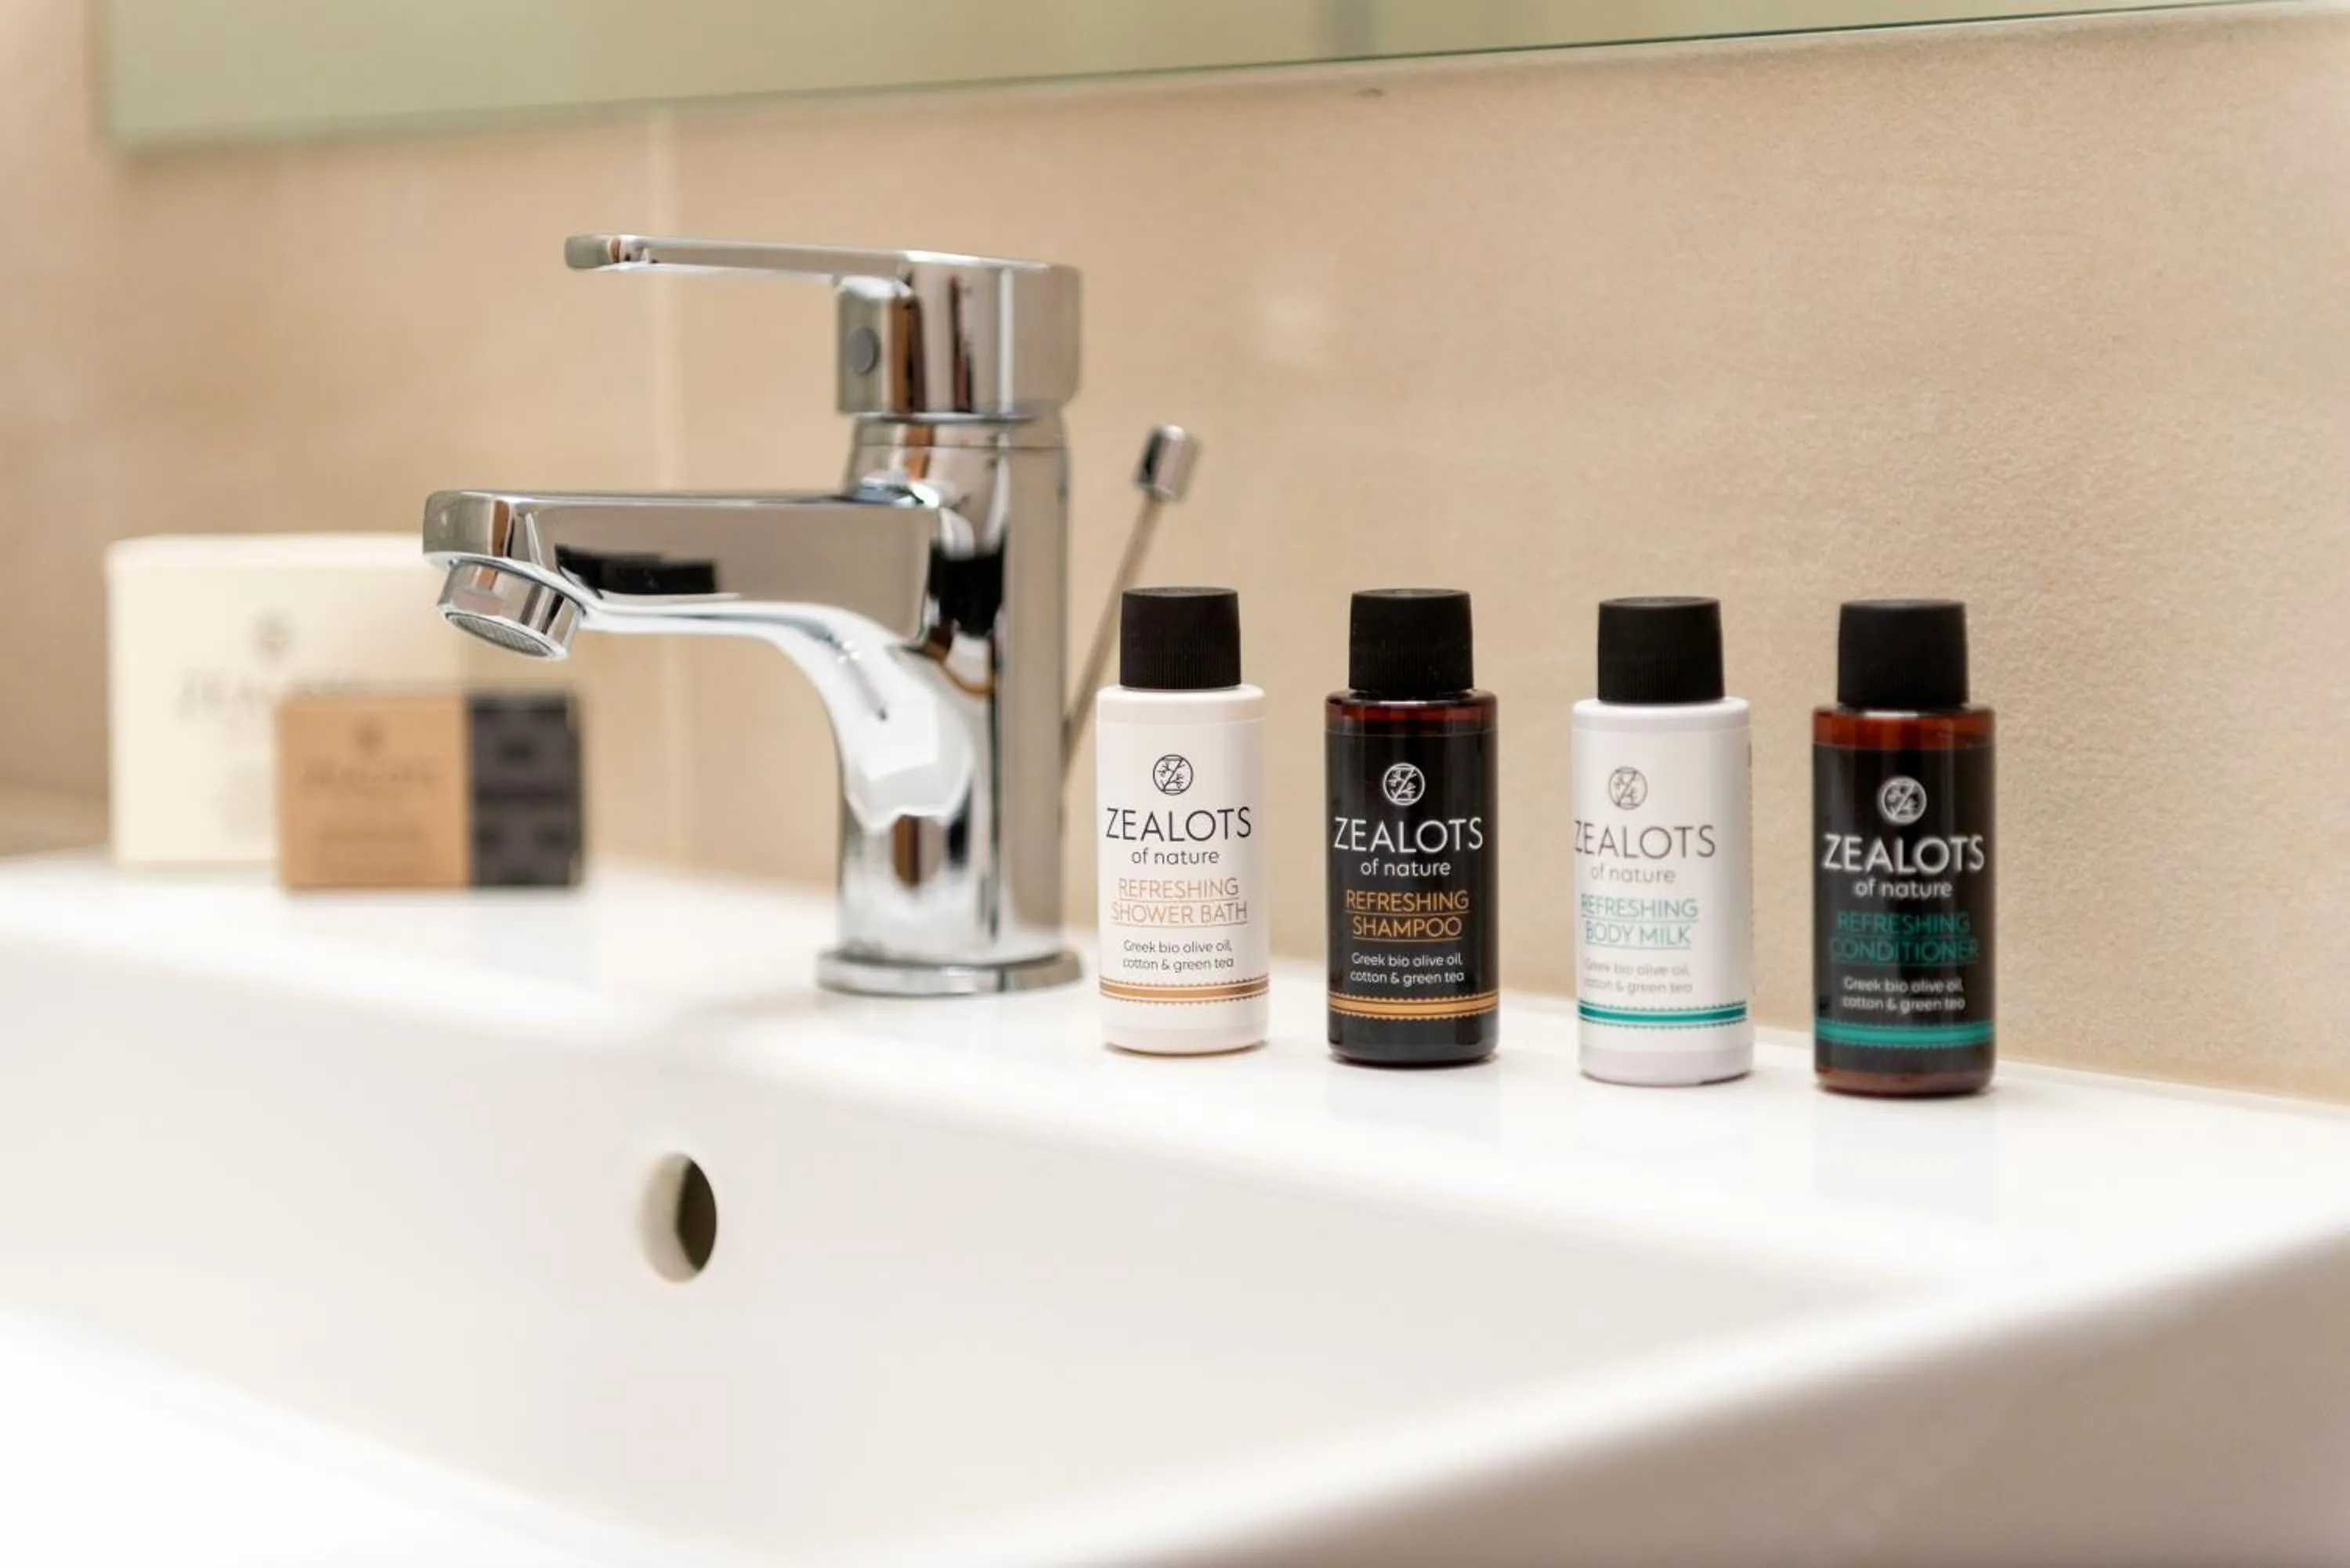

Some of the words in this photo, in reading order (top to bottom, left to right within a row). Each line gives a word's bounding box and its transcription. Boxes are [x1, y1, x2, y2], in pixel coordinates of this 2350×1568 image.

[1106, 806, 1252, 842] ZEALOTS
[1333, 816, 1484, 854] ZEALOTS
[1574, 819, 1716, 860] ZEALOTS
[1131, 847, 1148, 865] of
[1154, 850, 1220, 865] nature
[1822, 833, 1985, 875] ZEALOTS
[1361, 858, 1379, 876] of
[1384, 860, 1451, 877] nature
[1590, 862, 1605, 881] of
[1610, 866, 1676, 884] nature
[1119, 877, 1238, 899] REFRESHING
[1853, 877, 1875, 898] of
[1880, 879, 1953, 898] nature
[1346, 889, 1470, 912] REFRESHING
[1580, 892, 1699, 918] REFRESHING
[1111, 901, 1195, 924] SHOWER
[1201, 901, 1247, 923] BATH
[1838, 910, 1971, 935] REFRESHING
[1353, 916, 1462, 938] SHAMPOO
[1585, 919, 1634, 945] BODY
[1640, 923, 1692, 947] MILK
[1123, 939, 1155, 953] Greek
[1159, 939, 1179, 953] bio
[1183, 941, 1213, 953] olive
[1830, 938, 1980, 963] CONDITIONER
[1123, 957, 1158, 970] cotton
[1161, 958, 1170, 970] &
[1173, 960, 1212, 973] green
[1214, 957, 1234, 969] tea
[1351, 952, 1385, 966] Greek
[1388, 952, 1409, 967] bio
[1412, 953, 1444, 967] olive
[1614, 961, 1634, 976] bio
[1637, 962, 1668, 977] olive
[1350, 971, 1387, 984] cotton
[1390, 971, 1400, 984] &
[1404, 973, 1441, 987] green
[1444, 971, 1464, 982] tea
[1617, 980, 1625, 992] &
[1627, 981, 1667, 996] green
[1669, 981, 1692, 992] tea
[1842, 977, 1880, 992] Greek
[1885, 977, 1908, 993] bio
[1911, 978, 1943, 993] olive
[1842, 996, 1884, 1010] cotton
[1887, 998, 1897, 1011] &
[1900, 999, 1942, 1013] green
[1944, 997, 1965, 1010] tea
